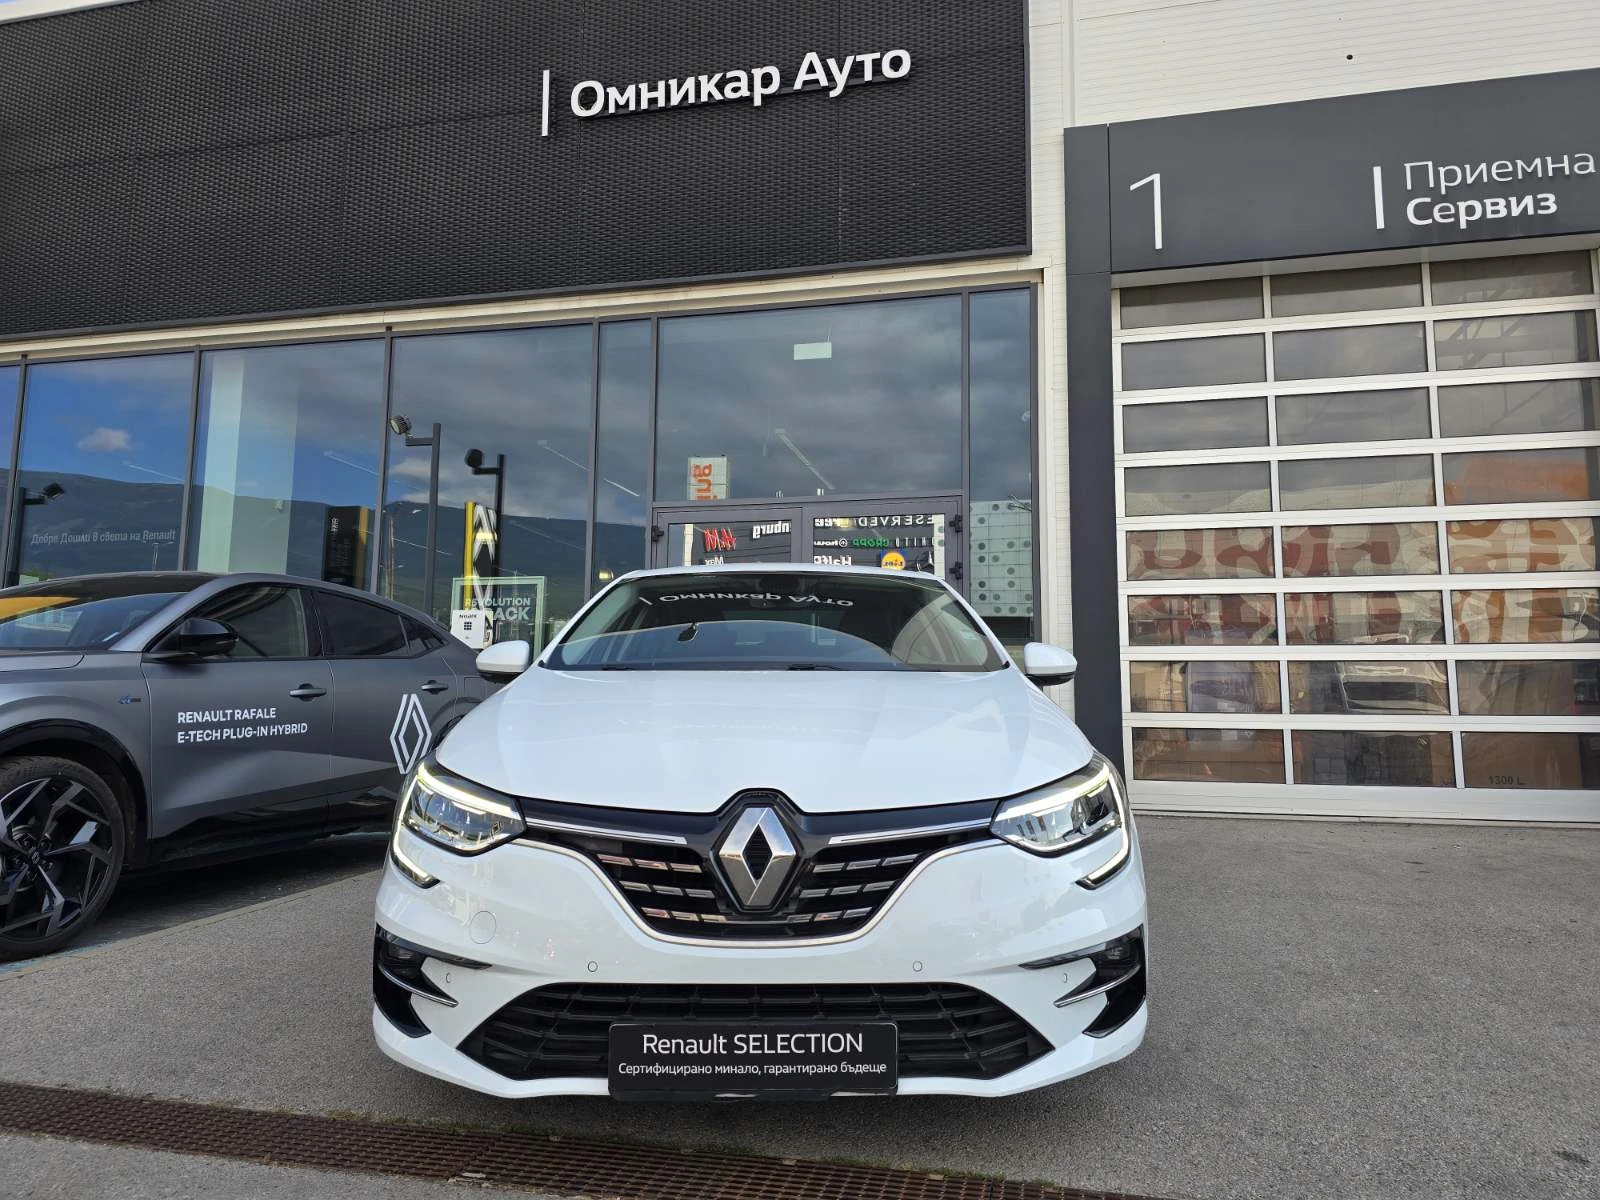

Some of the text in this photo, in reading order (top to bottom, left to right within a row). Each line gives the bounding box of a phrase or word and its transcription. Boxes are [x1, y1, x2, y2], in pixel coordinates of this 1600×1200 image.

[571, 49, 912, 117] Омникар Ауто
[1404, 153, 1597, 195] Приемна
[1130, 173, 1163, 249] 1
[1406, 193, 1558, 229] Сервиз
[143, 529, 176, 541] Renault
[177, 707, 277, 724] RENAULT RAFALE
[177, 722, 308, 743] E-TECH PLUG-IN HYBRID
[1488, 775, 1514, 785] 1300
[643, 1033, 863, 1054] Renault SELECTION
[618, 1061, 887, 1076] Сертифицирано минало, гарантирано бъдеще
